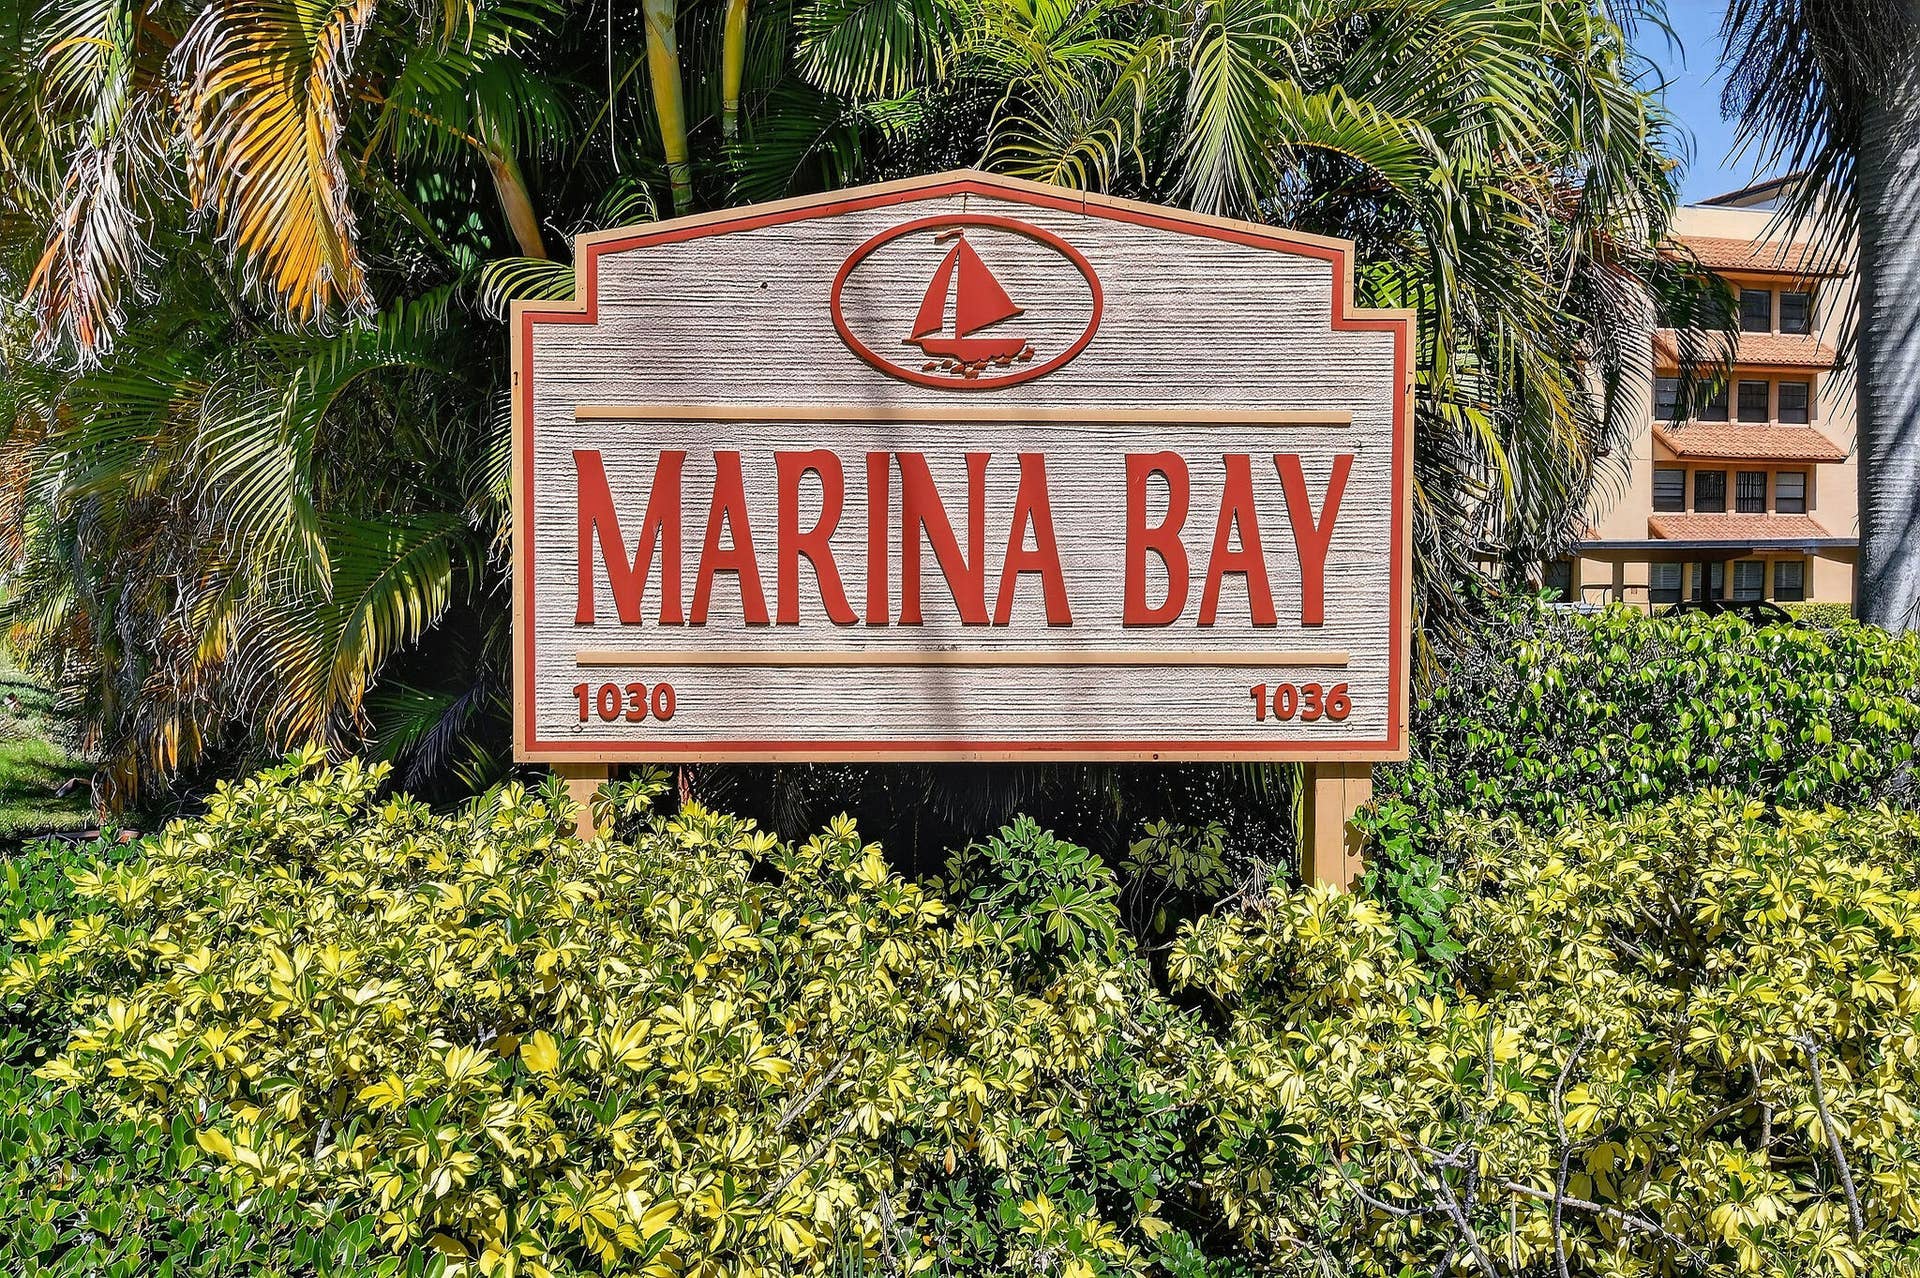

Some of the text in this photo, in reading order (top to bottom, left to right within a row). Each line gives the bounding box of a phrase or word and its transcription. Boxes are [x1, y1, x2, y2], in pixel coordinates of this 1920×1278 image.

[572, 449, 1355, 629] MARINA BAY
[572, 682, 676, 722] 1030
[1249, 682, 1352, 722] 1036
